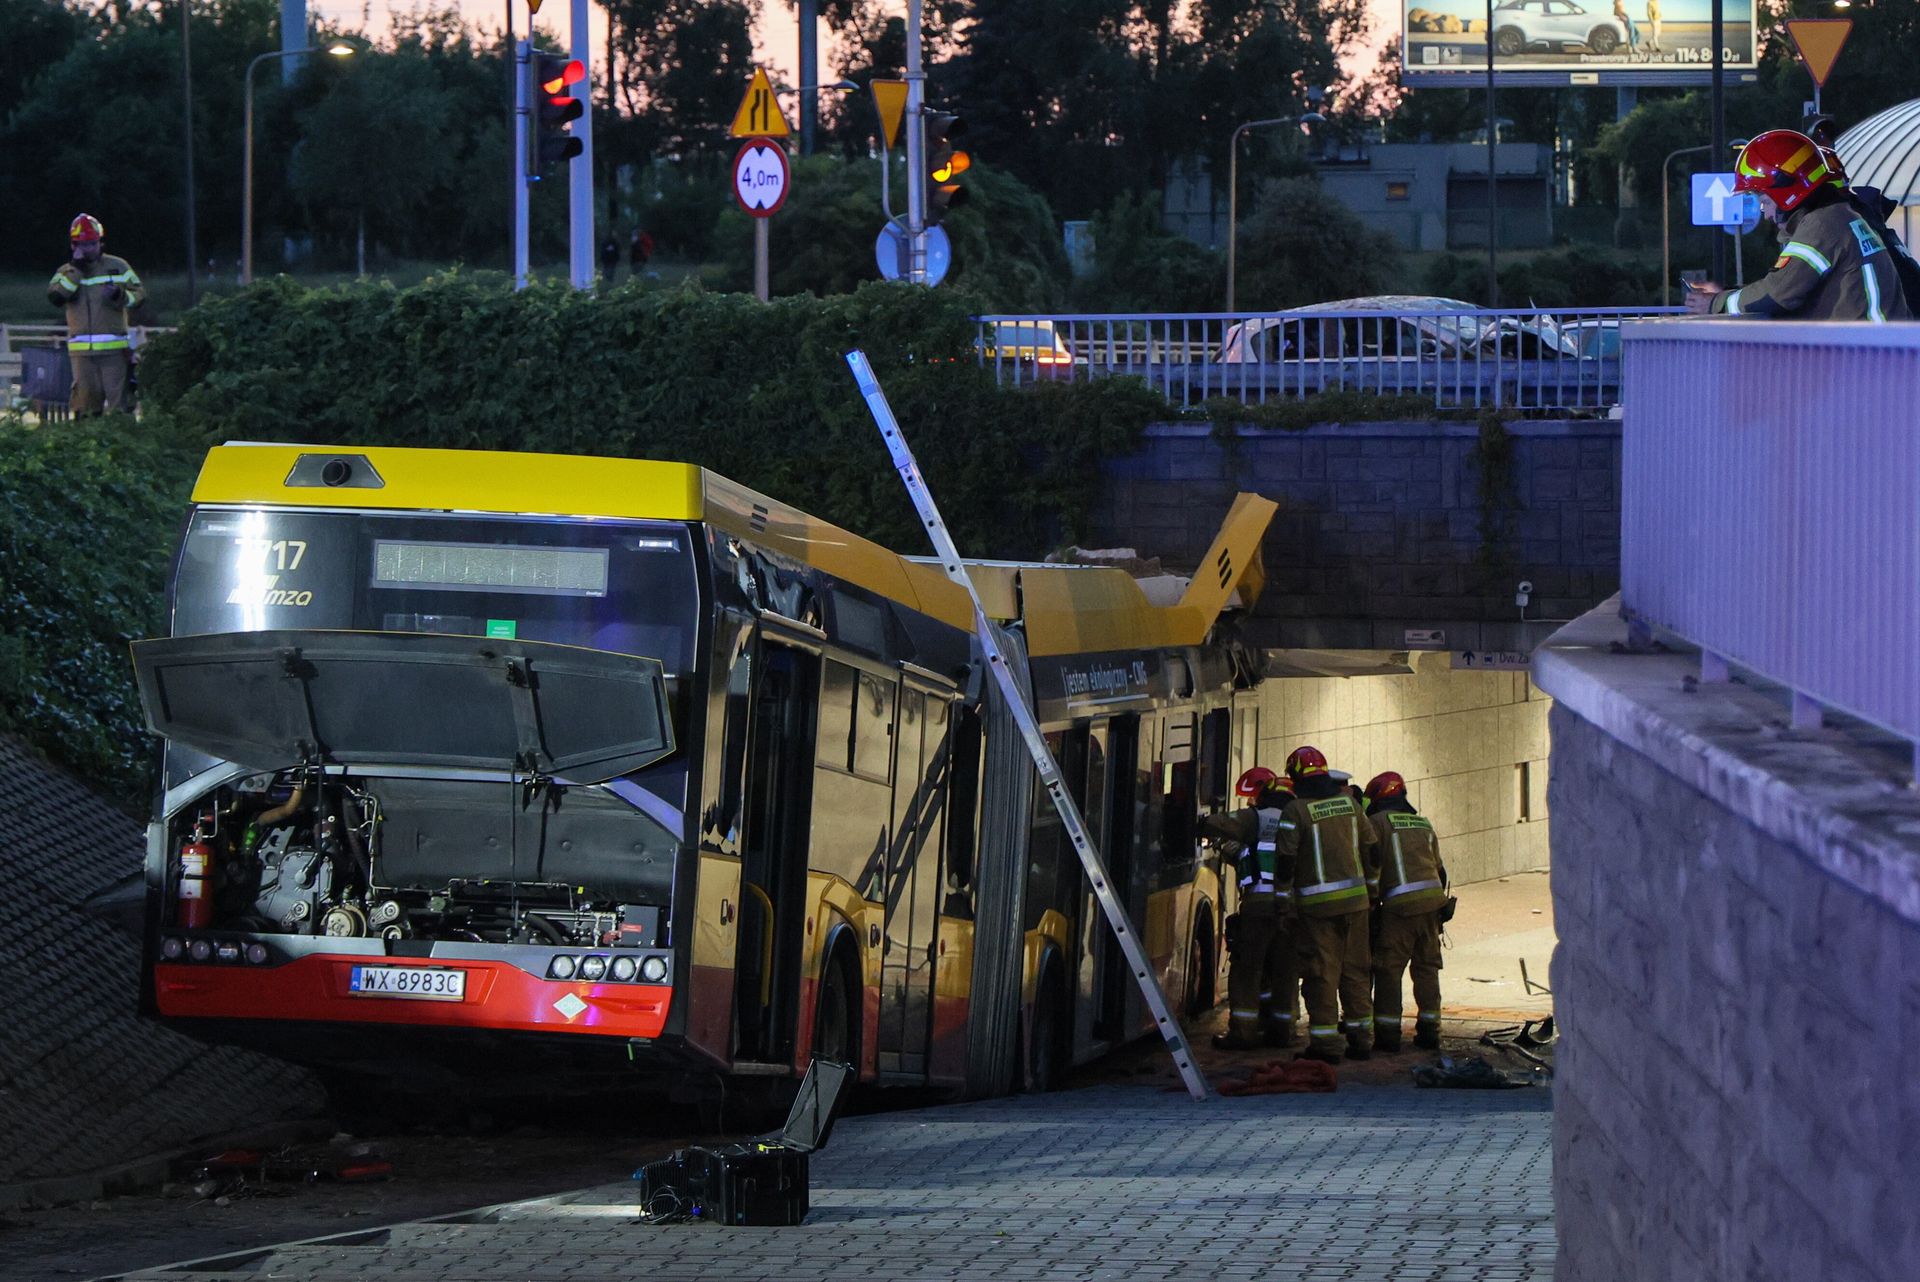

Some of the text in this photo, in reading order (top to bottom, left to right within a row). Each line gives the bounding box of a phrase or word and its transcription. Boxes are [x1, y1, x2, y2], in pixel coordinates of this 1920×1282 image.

[1664, 54, 1675, 63] od
[1701, 47, 1732, 62] 80
[742, 166, 779, 189] 4,0m
[364, 969, 390, 990] WX
[397, 971, 459, 993] 8983C
